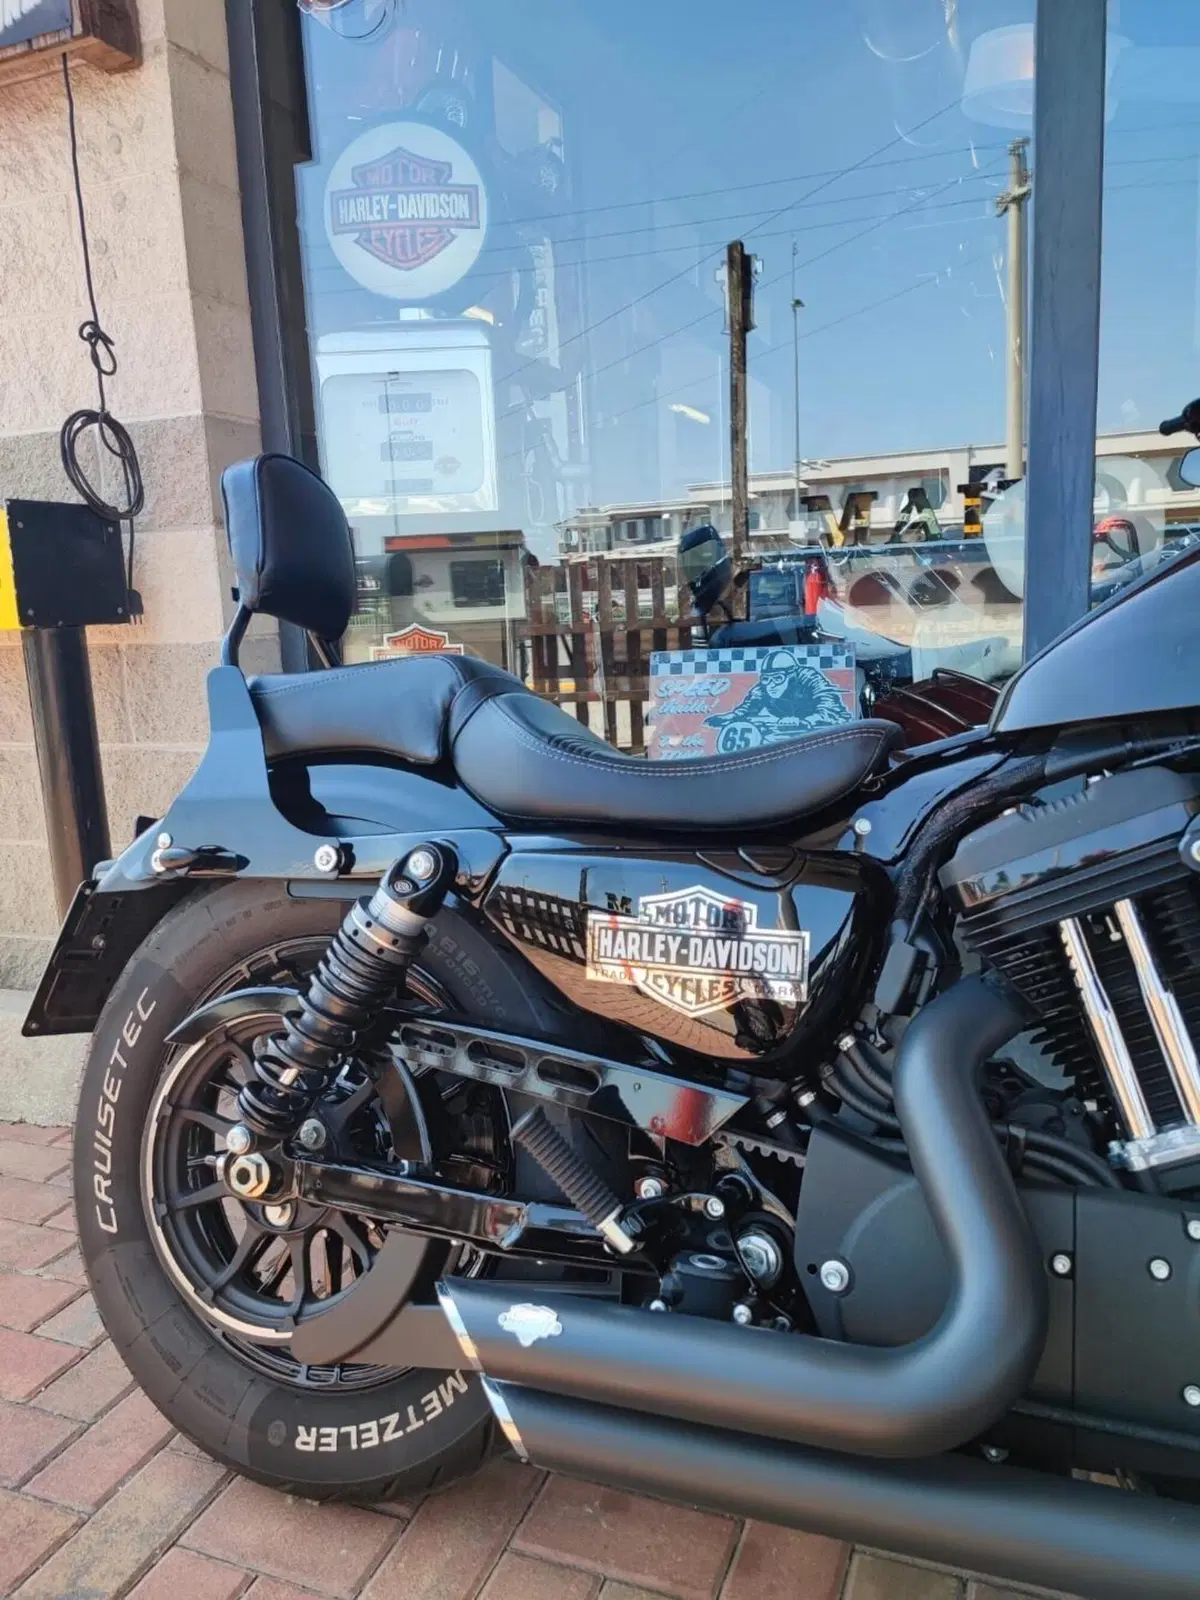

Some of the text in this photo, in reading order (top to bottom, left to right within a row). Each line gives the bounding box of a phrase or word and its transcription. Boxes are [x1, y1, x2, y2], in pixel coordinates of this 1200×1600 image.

[367, 158, 437, 186] MOTOR
[339, 192, 470, 225] HARLEY-DAVIDSON
[371, 228, 440, 261] CYCLES
[397, 635, 437, 650] MOTOR
[722, 727, 752, 752] 65
[655, 897, 746, 928] MOTOR
[599, 928, 798, 974] HARLEY-DAVIDSON
[651, 974, 736, 1005] CYCLES
[93, 987, 158, 1235] CRUISETEC
[293, 1369, 470, 1453] METZELER
